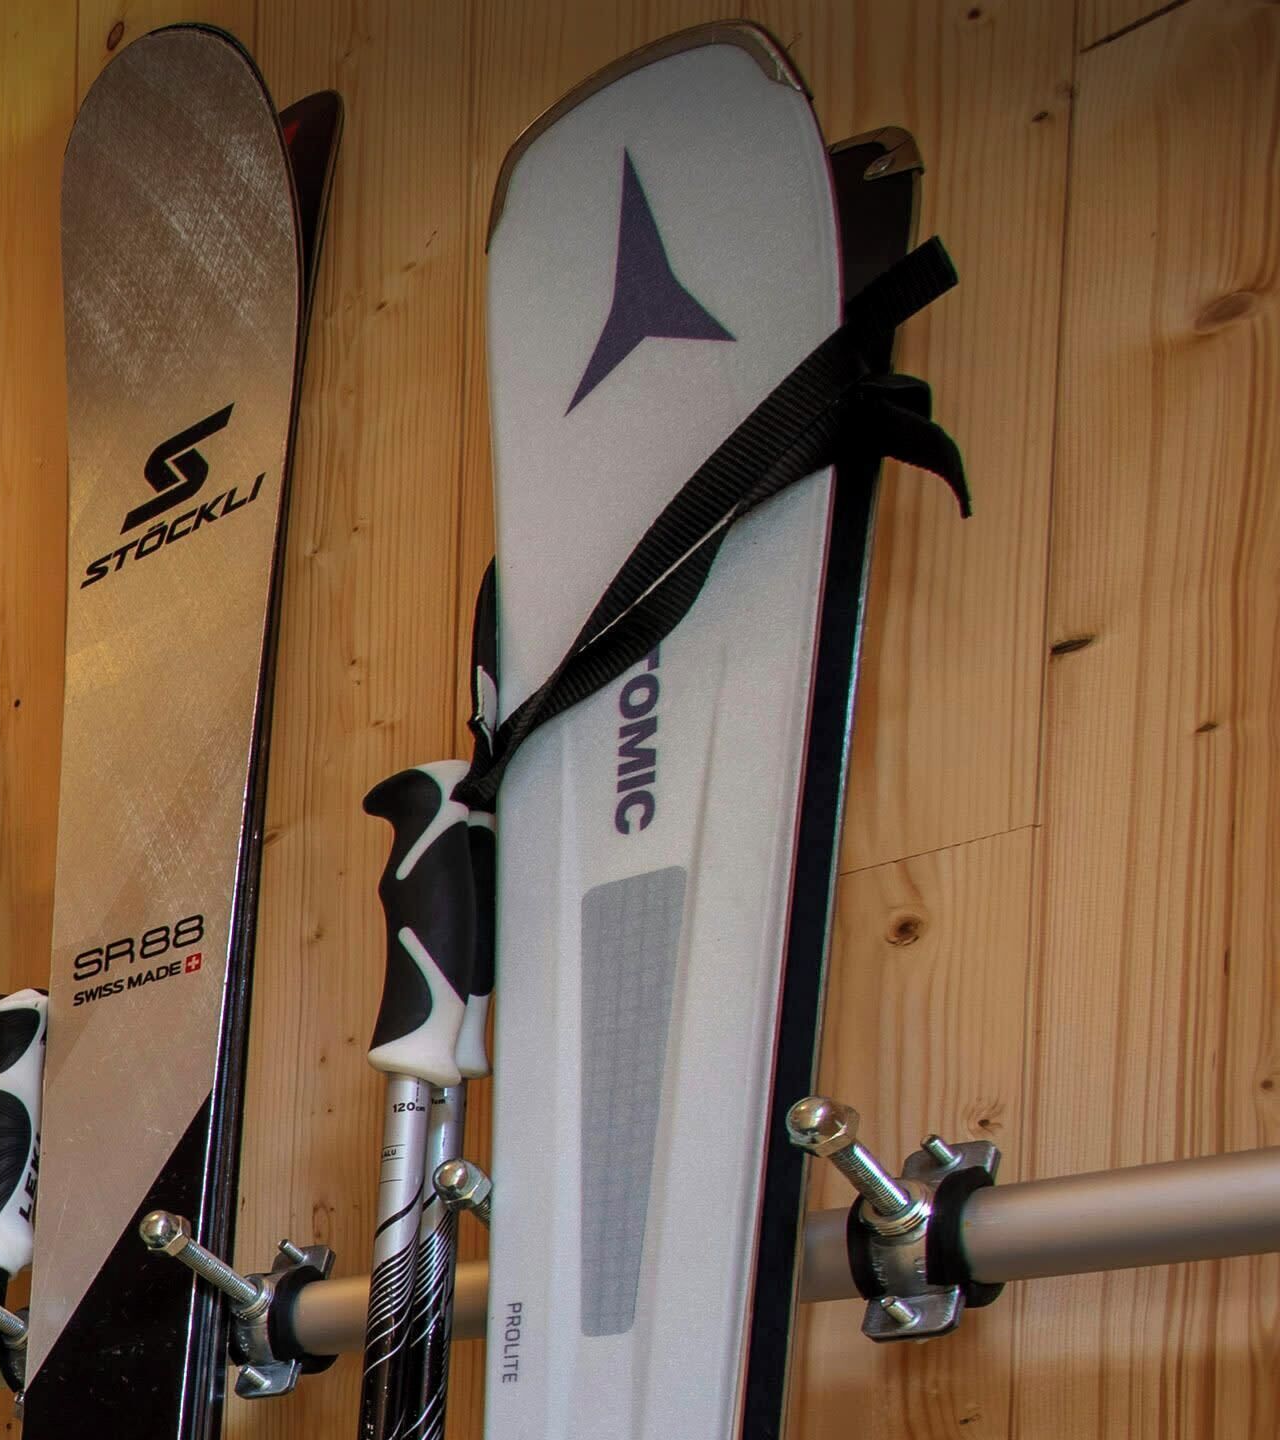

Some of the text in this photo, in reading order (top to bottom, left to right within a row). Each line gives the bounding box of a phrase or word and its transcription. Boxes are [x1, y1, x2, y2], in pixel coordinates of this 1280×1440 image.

[80, 472, 266, 589] STÖCKLI
[72, 961, 181, 1007] SWISS MADE
[502, 1302, 522, 1383] PROLITE
